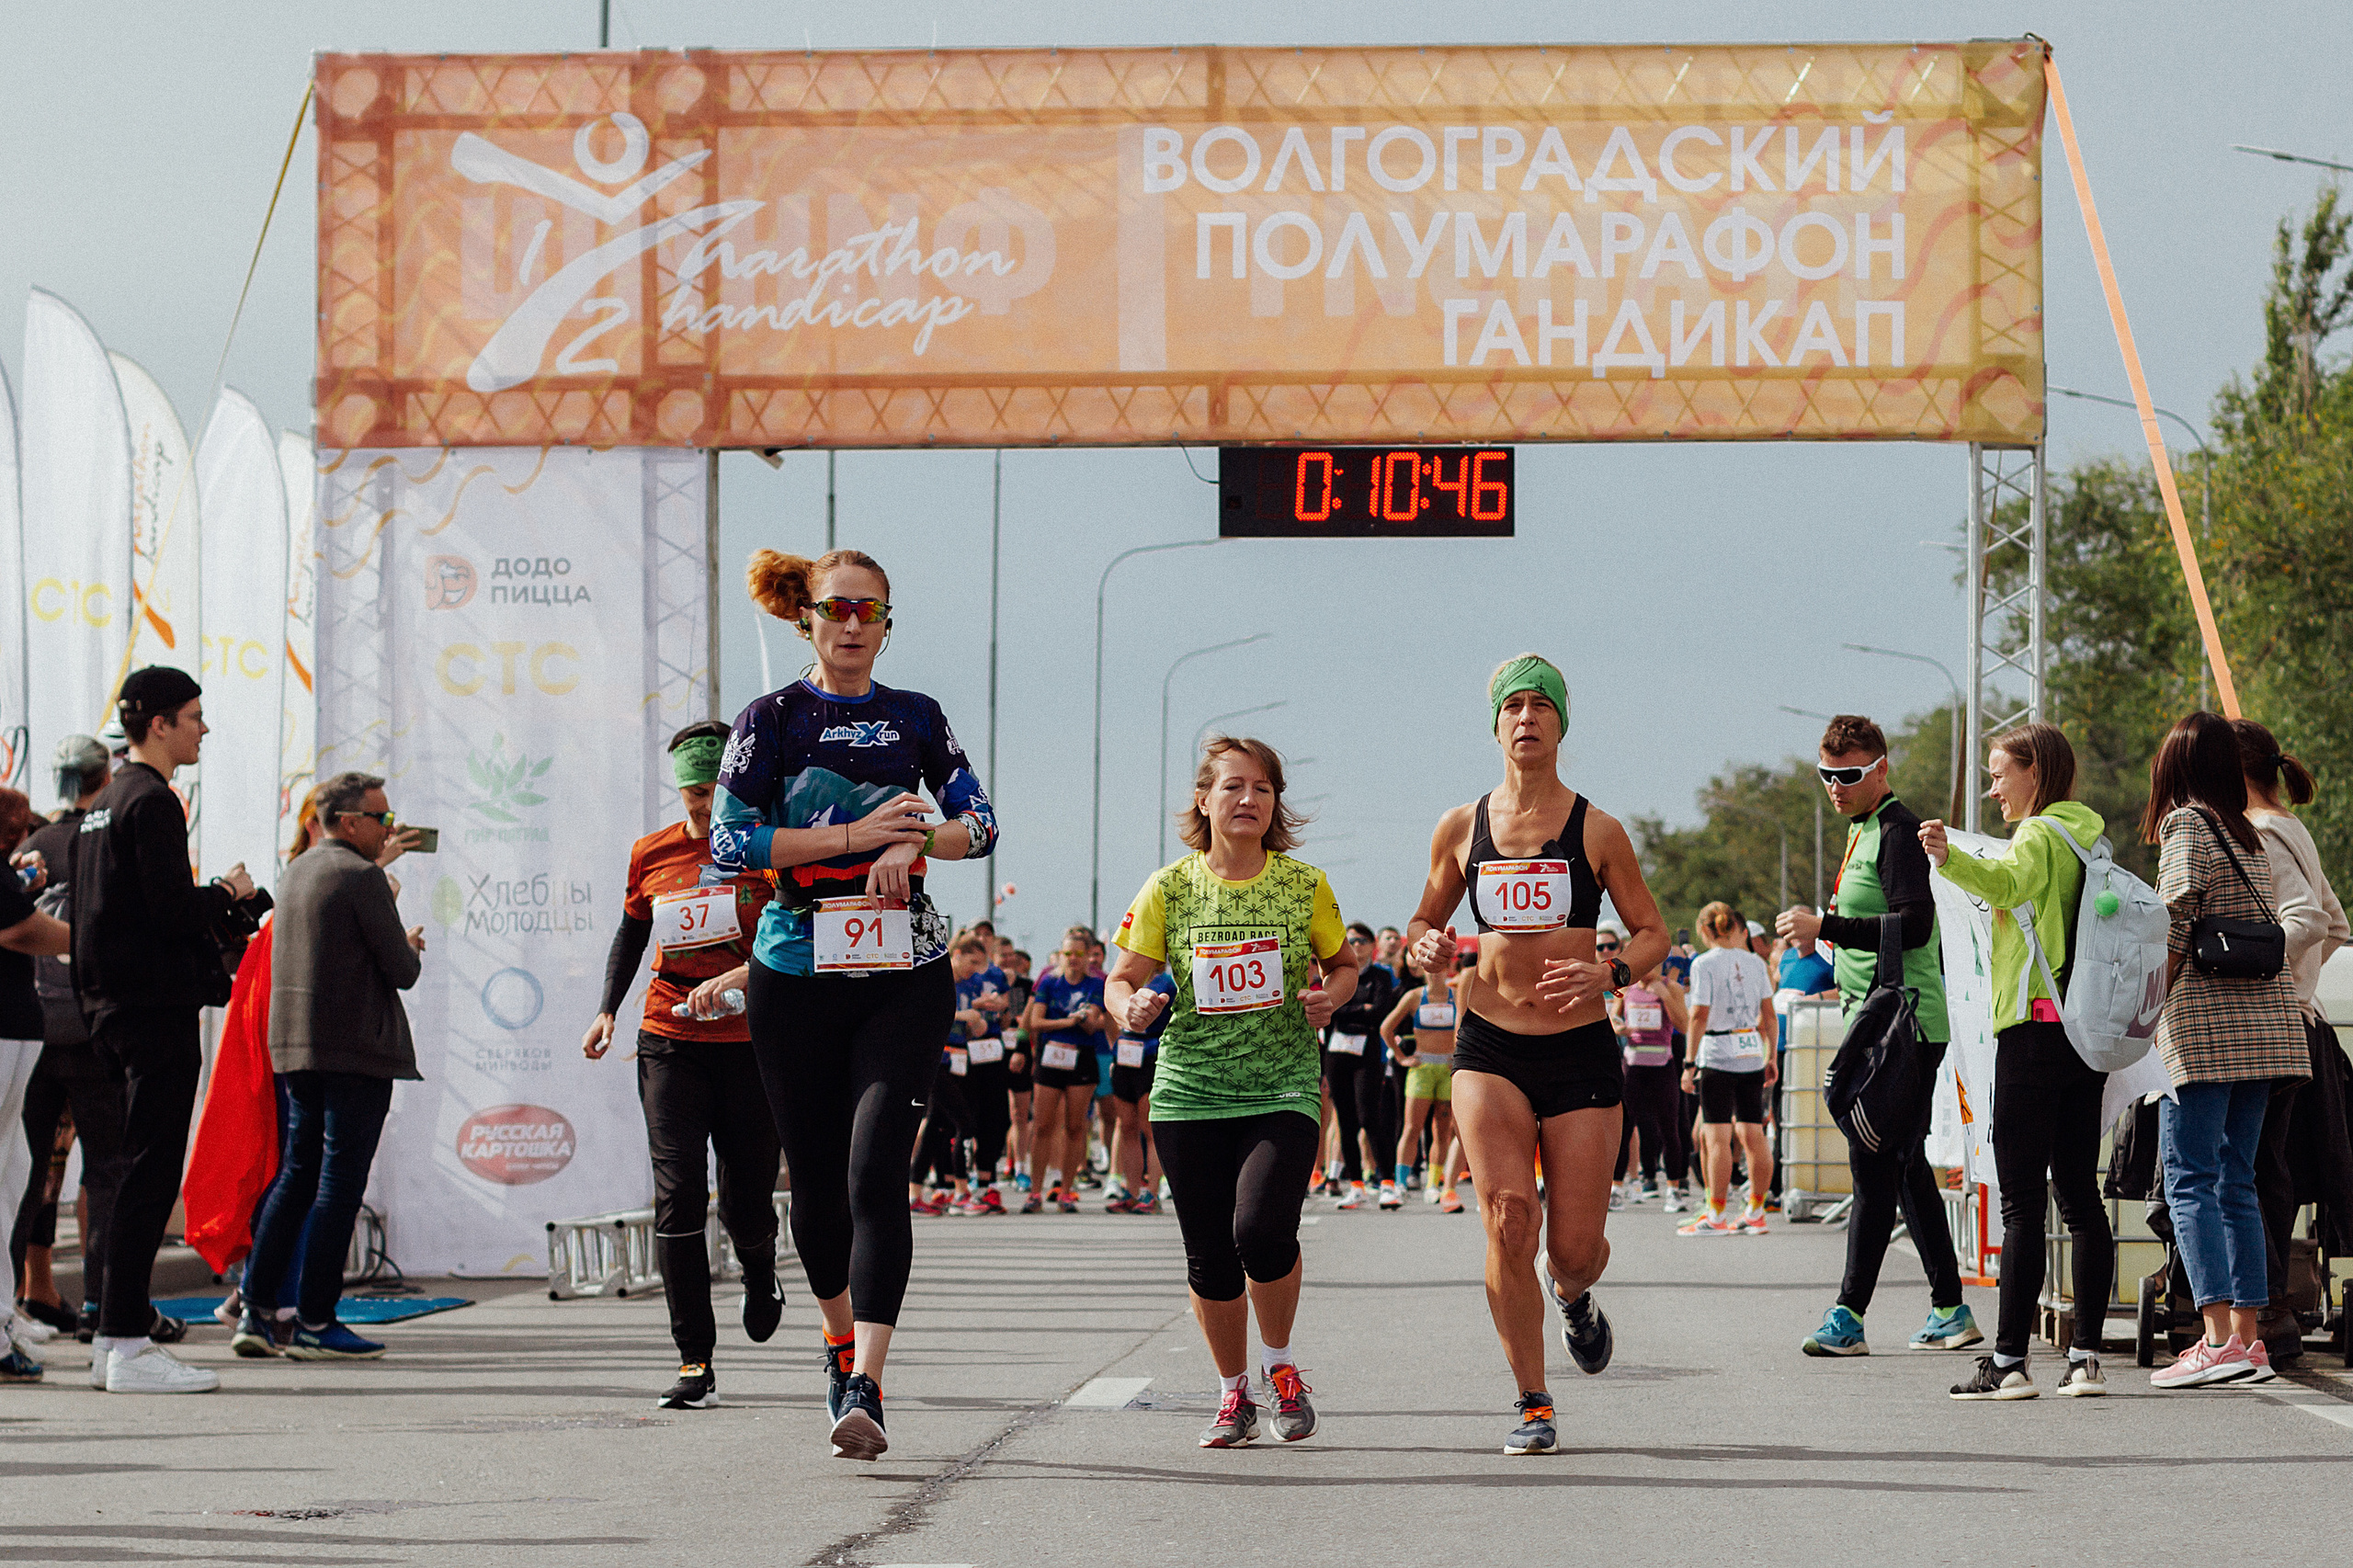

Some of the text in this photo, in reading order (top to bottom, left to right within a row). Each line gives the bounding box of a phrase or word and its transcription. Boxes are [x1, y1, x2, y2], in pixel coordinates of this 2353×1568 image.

[1142, 109, 1906, 204] ВОЛГОГРАДСКИЙ
[1196, 207, 1906, 282] ПОЛУМАРАФОН
[660, 275, 975, 358] handicap
[1443, 299, 1906, 379] ГАНДИКАП
[1295, 451, 1508, 522] 0:10:46
[491, 556, 572, 580] ДОДО
[490, 585, 593, 608] ПИЦЦА
[435, 641, 582, 697] СТС
[1495, 881, 1552, 911] 105
[679, 903, 710, 931] 37
[844, 917, 883, 949] 91
[1198, 931, 1245, 943] BEZROAD
[1209, 960, 1267, 993] 103
[1738, 1035, 1758, 1050] 543
